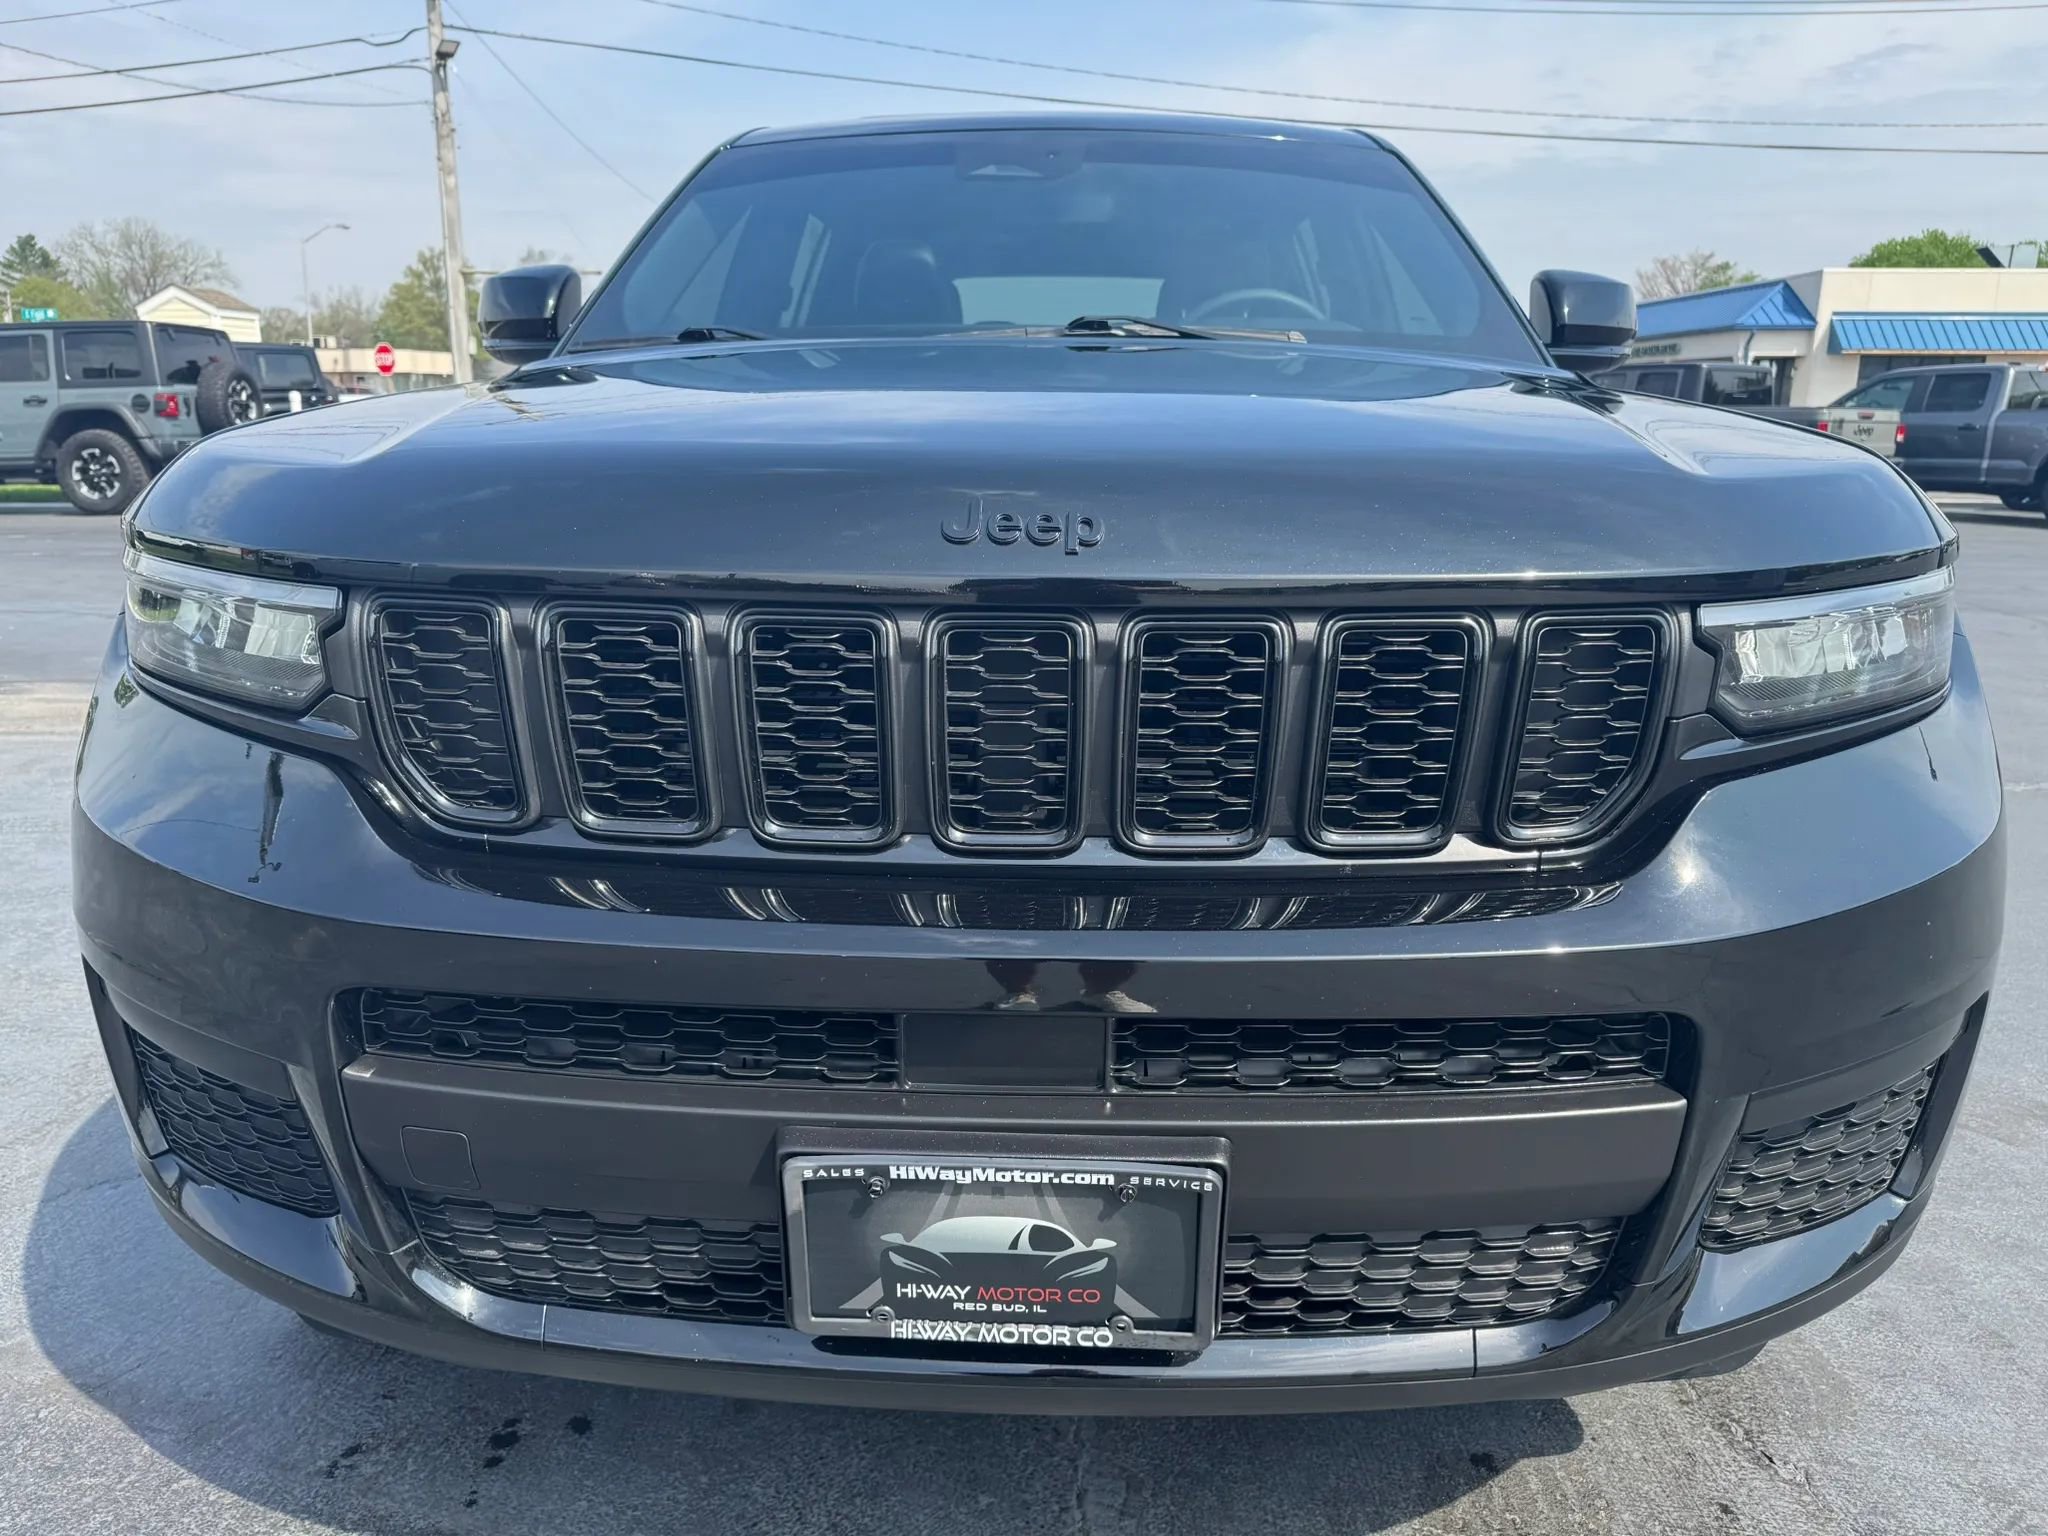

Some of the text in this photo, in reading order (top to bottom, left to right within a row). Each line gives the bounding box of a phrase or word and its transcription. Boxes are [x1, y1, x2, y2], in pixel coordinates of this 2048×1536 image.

[941, 498, 1105, 556] Jeep
[802, 1167, 865, 1178] SALES
[888, 1165, 1115, 1186] HiWayMotor.com
[1129, 1175, 1213, 1192] SERVICE
[896, 1282, 1101, 1304] HI-WAY MOTOR CO
[953, 1302, 1048, 1314] RED BUD, IL
[890, 1320, 1114, 1348] HI-WAY MOTOR CO
